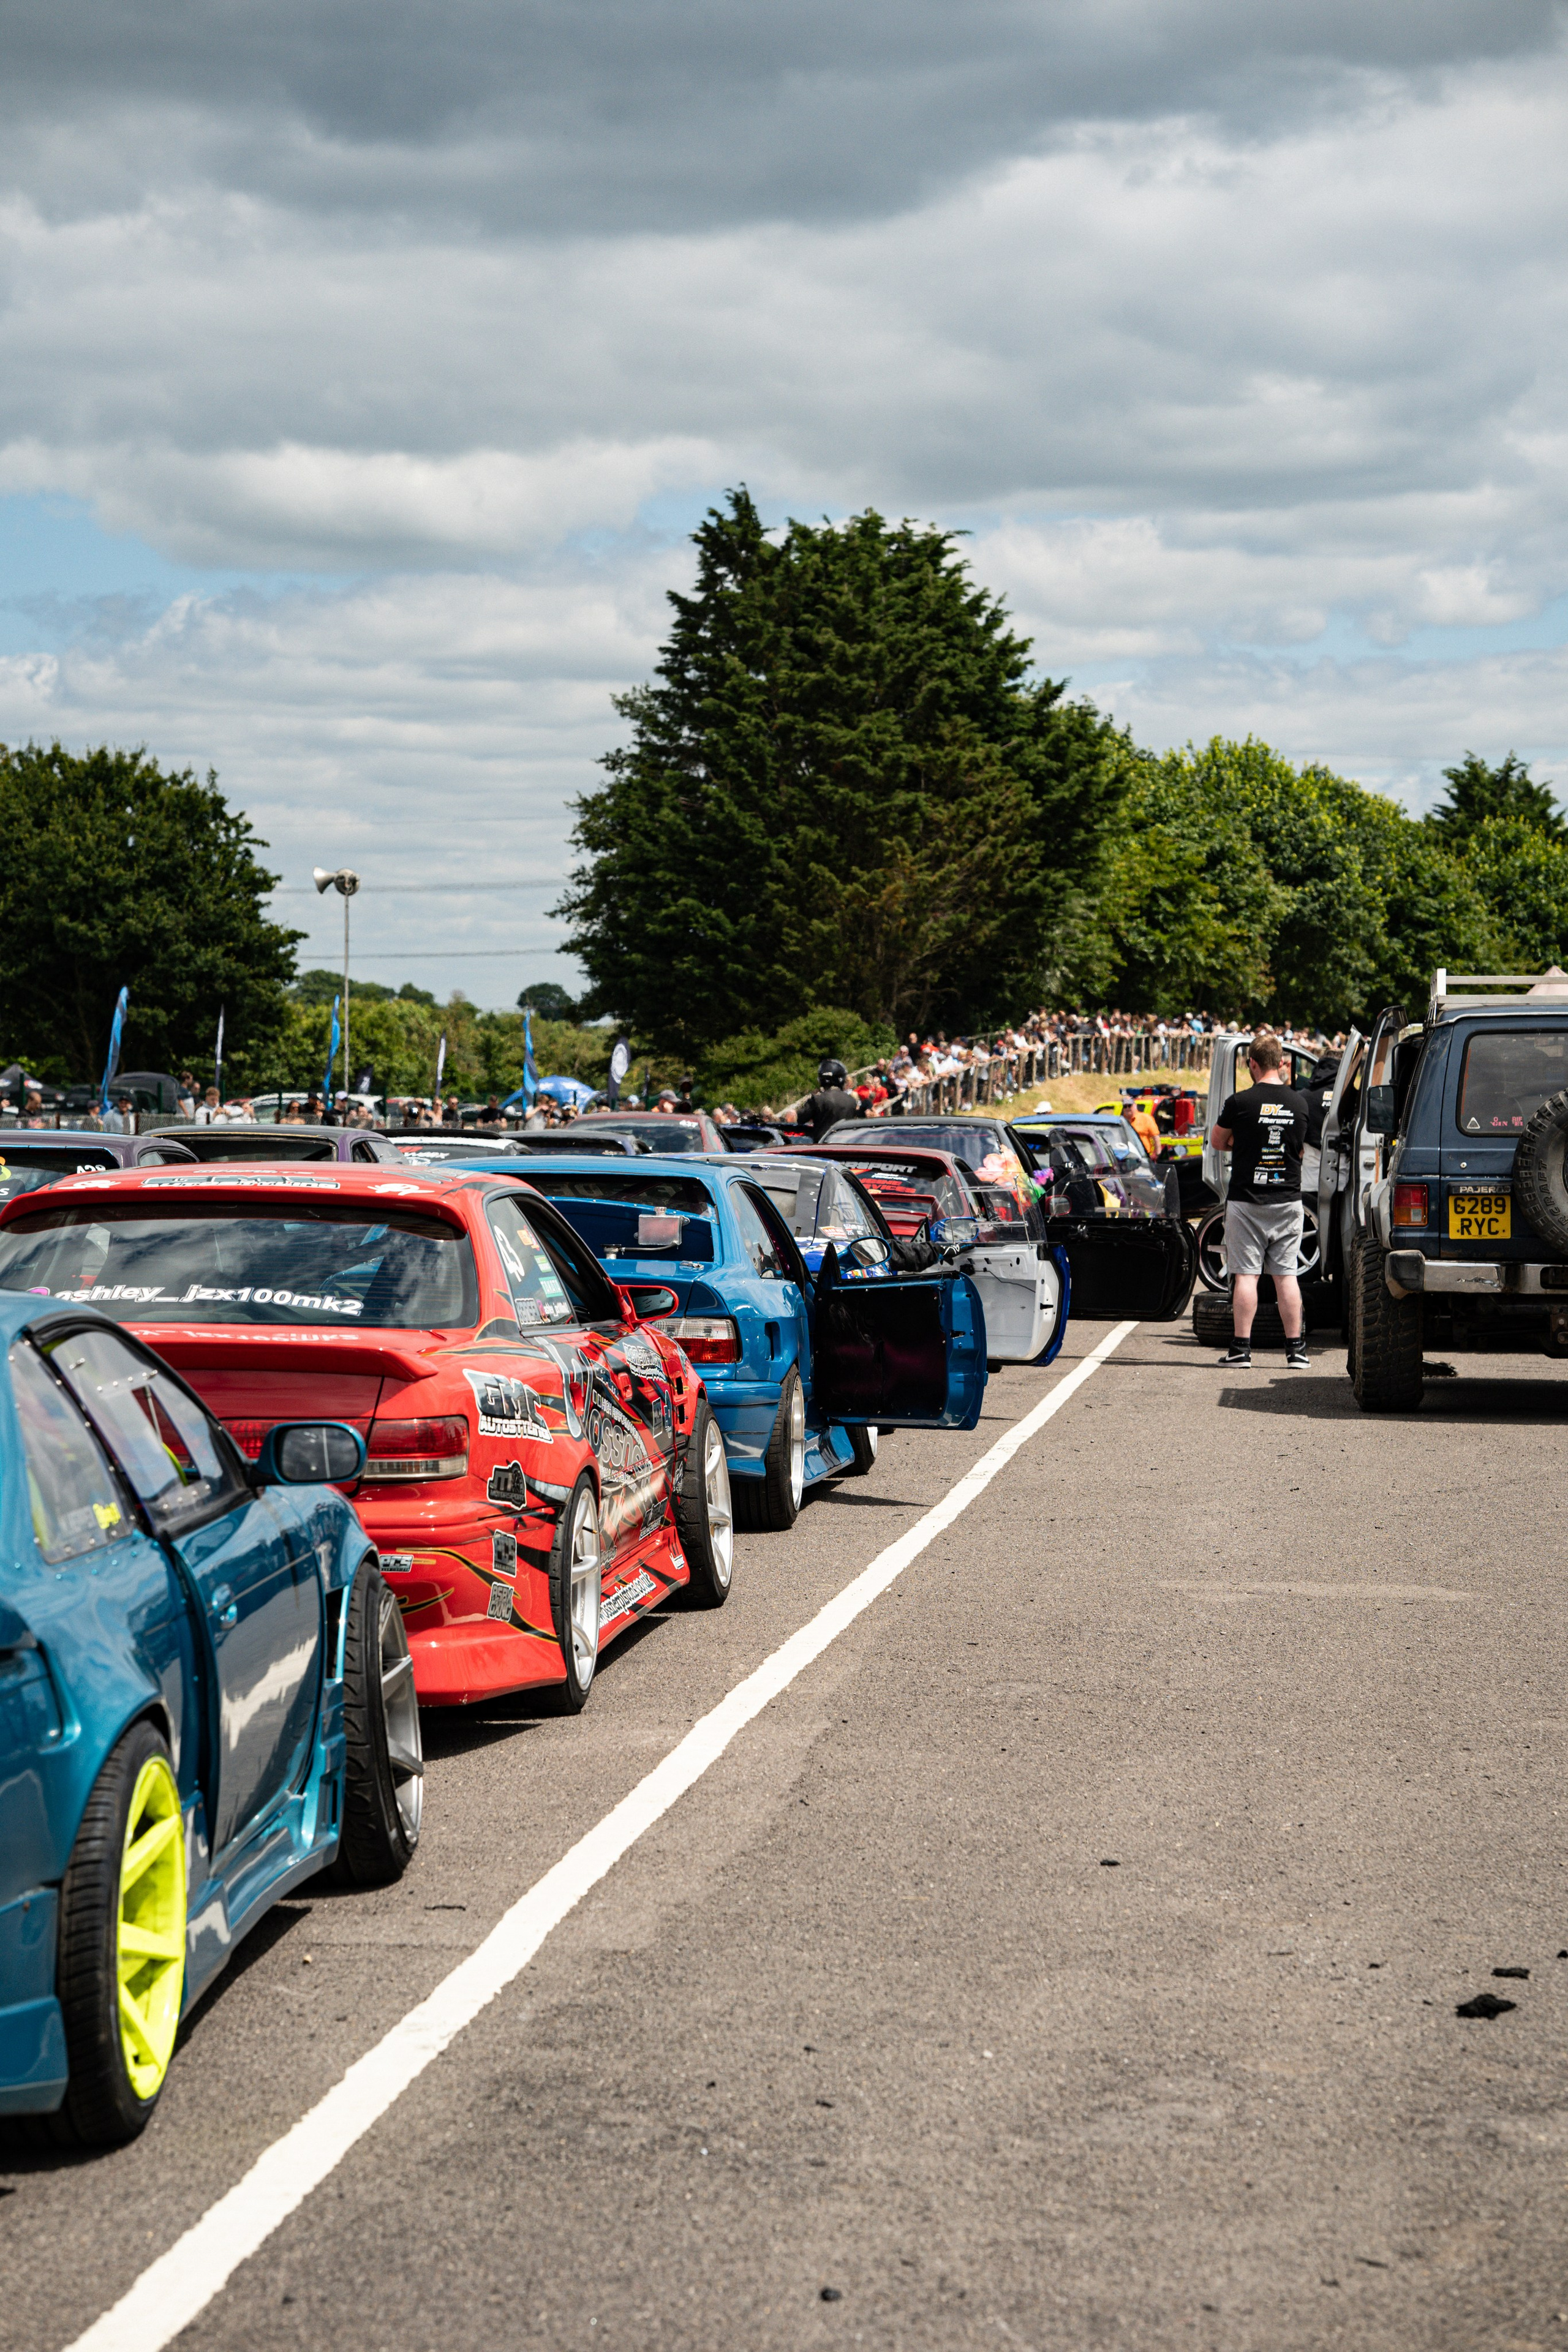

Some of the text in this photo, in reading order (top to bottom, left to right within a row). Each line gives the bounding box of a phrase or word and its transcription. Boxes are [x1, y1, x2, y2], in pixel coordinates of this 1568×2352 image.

[1260, 1104, 1284, 1115] DY
[1453, 1197, 1506, 1215] G289
[1460, 1218, 1499, 1235] RYC
[462, 1368, 548, 1430] GMC
